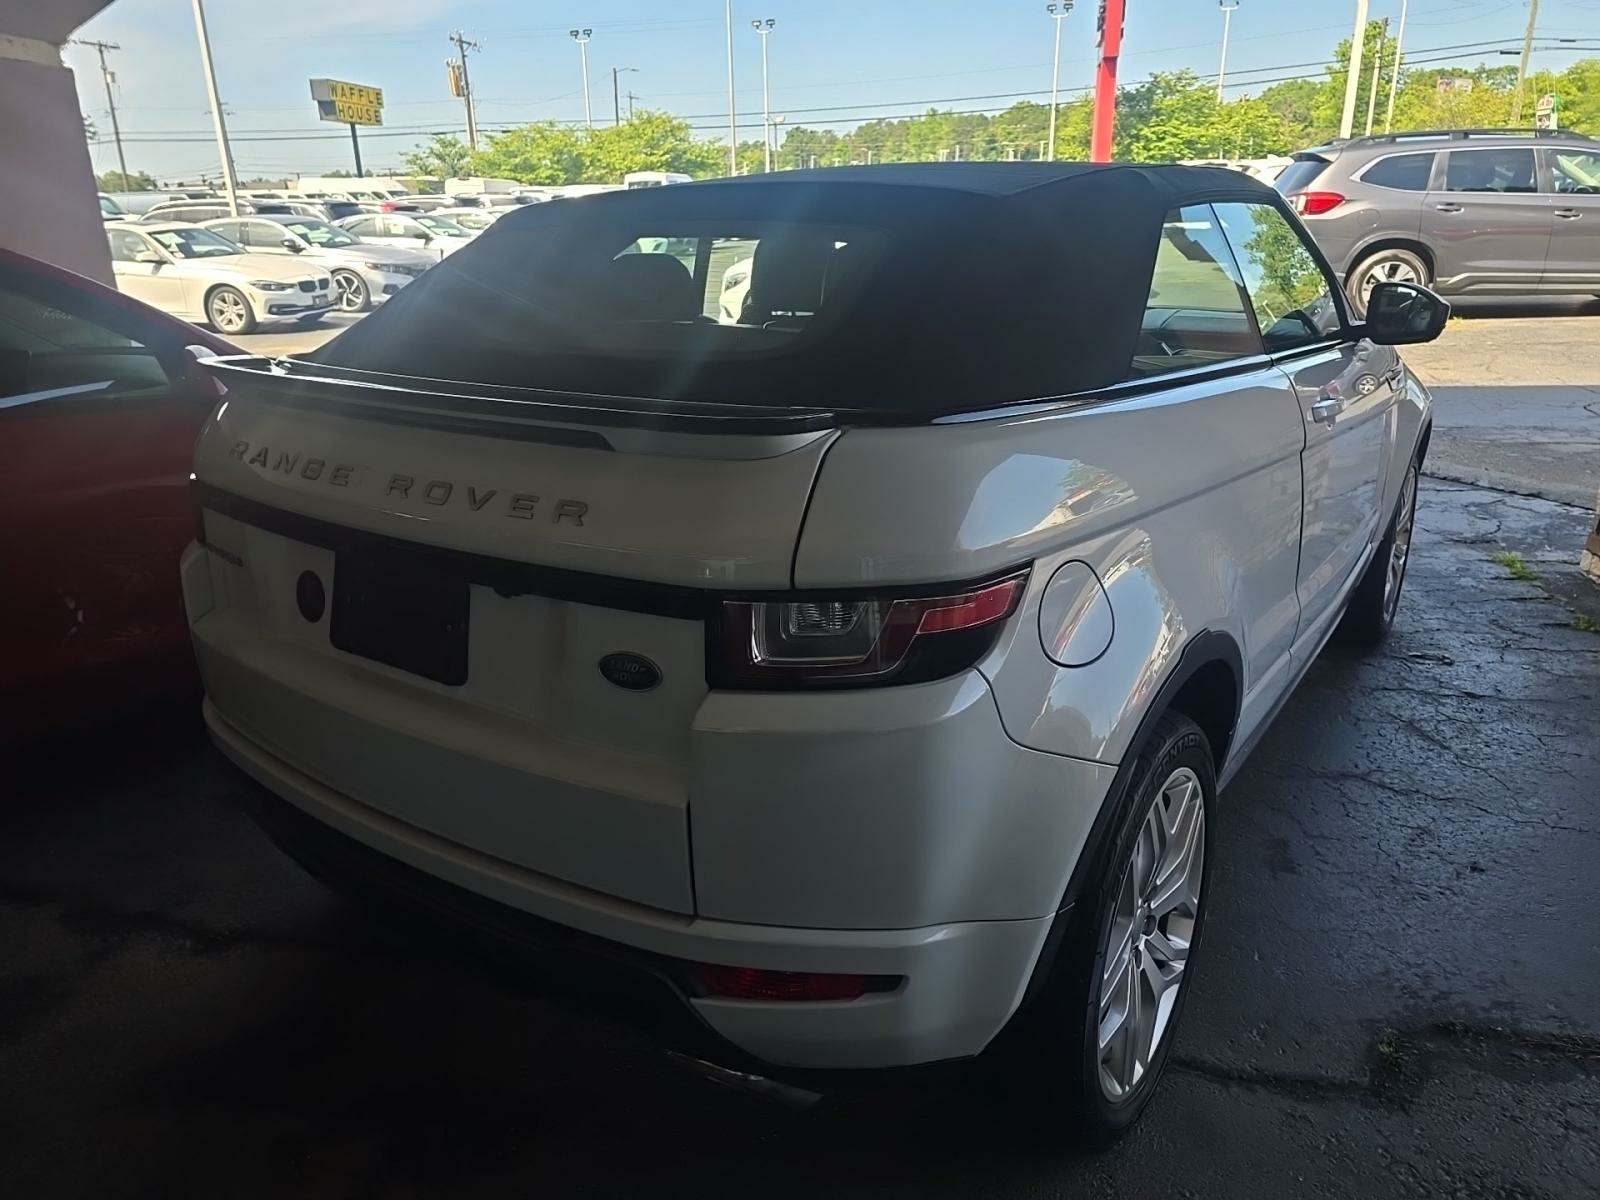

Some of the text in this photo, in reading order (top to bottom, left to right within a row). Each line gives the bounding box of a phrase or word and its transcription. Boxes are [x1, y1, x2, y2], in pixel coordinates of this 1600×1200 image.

[330, 84, 382, 105] WAFFLE
[338, 104, 381, 122] HOUSE
[229, 440, 589, 527] RANGE ROVER
